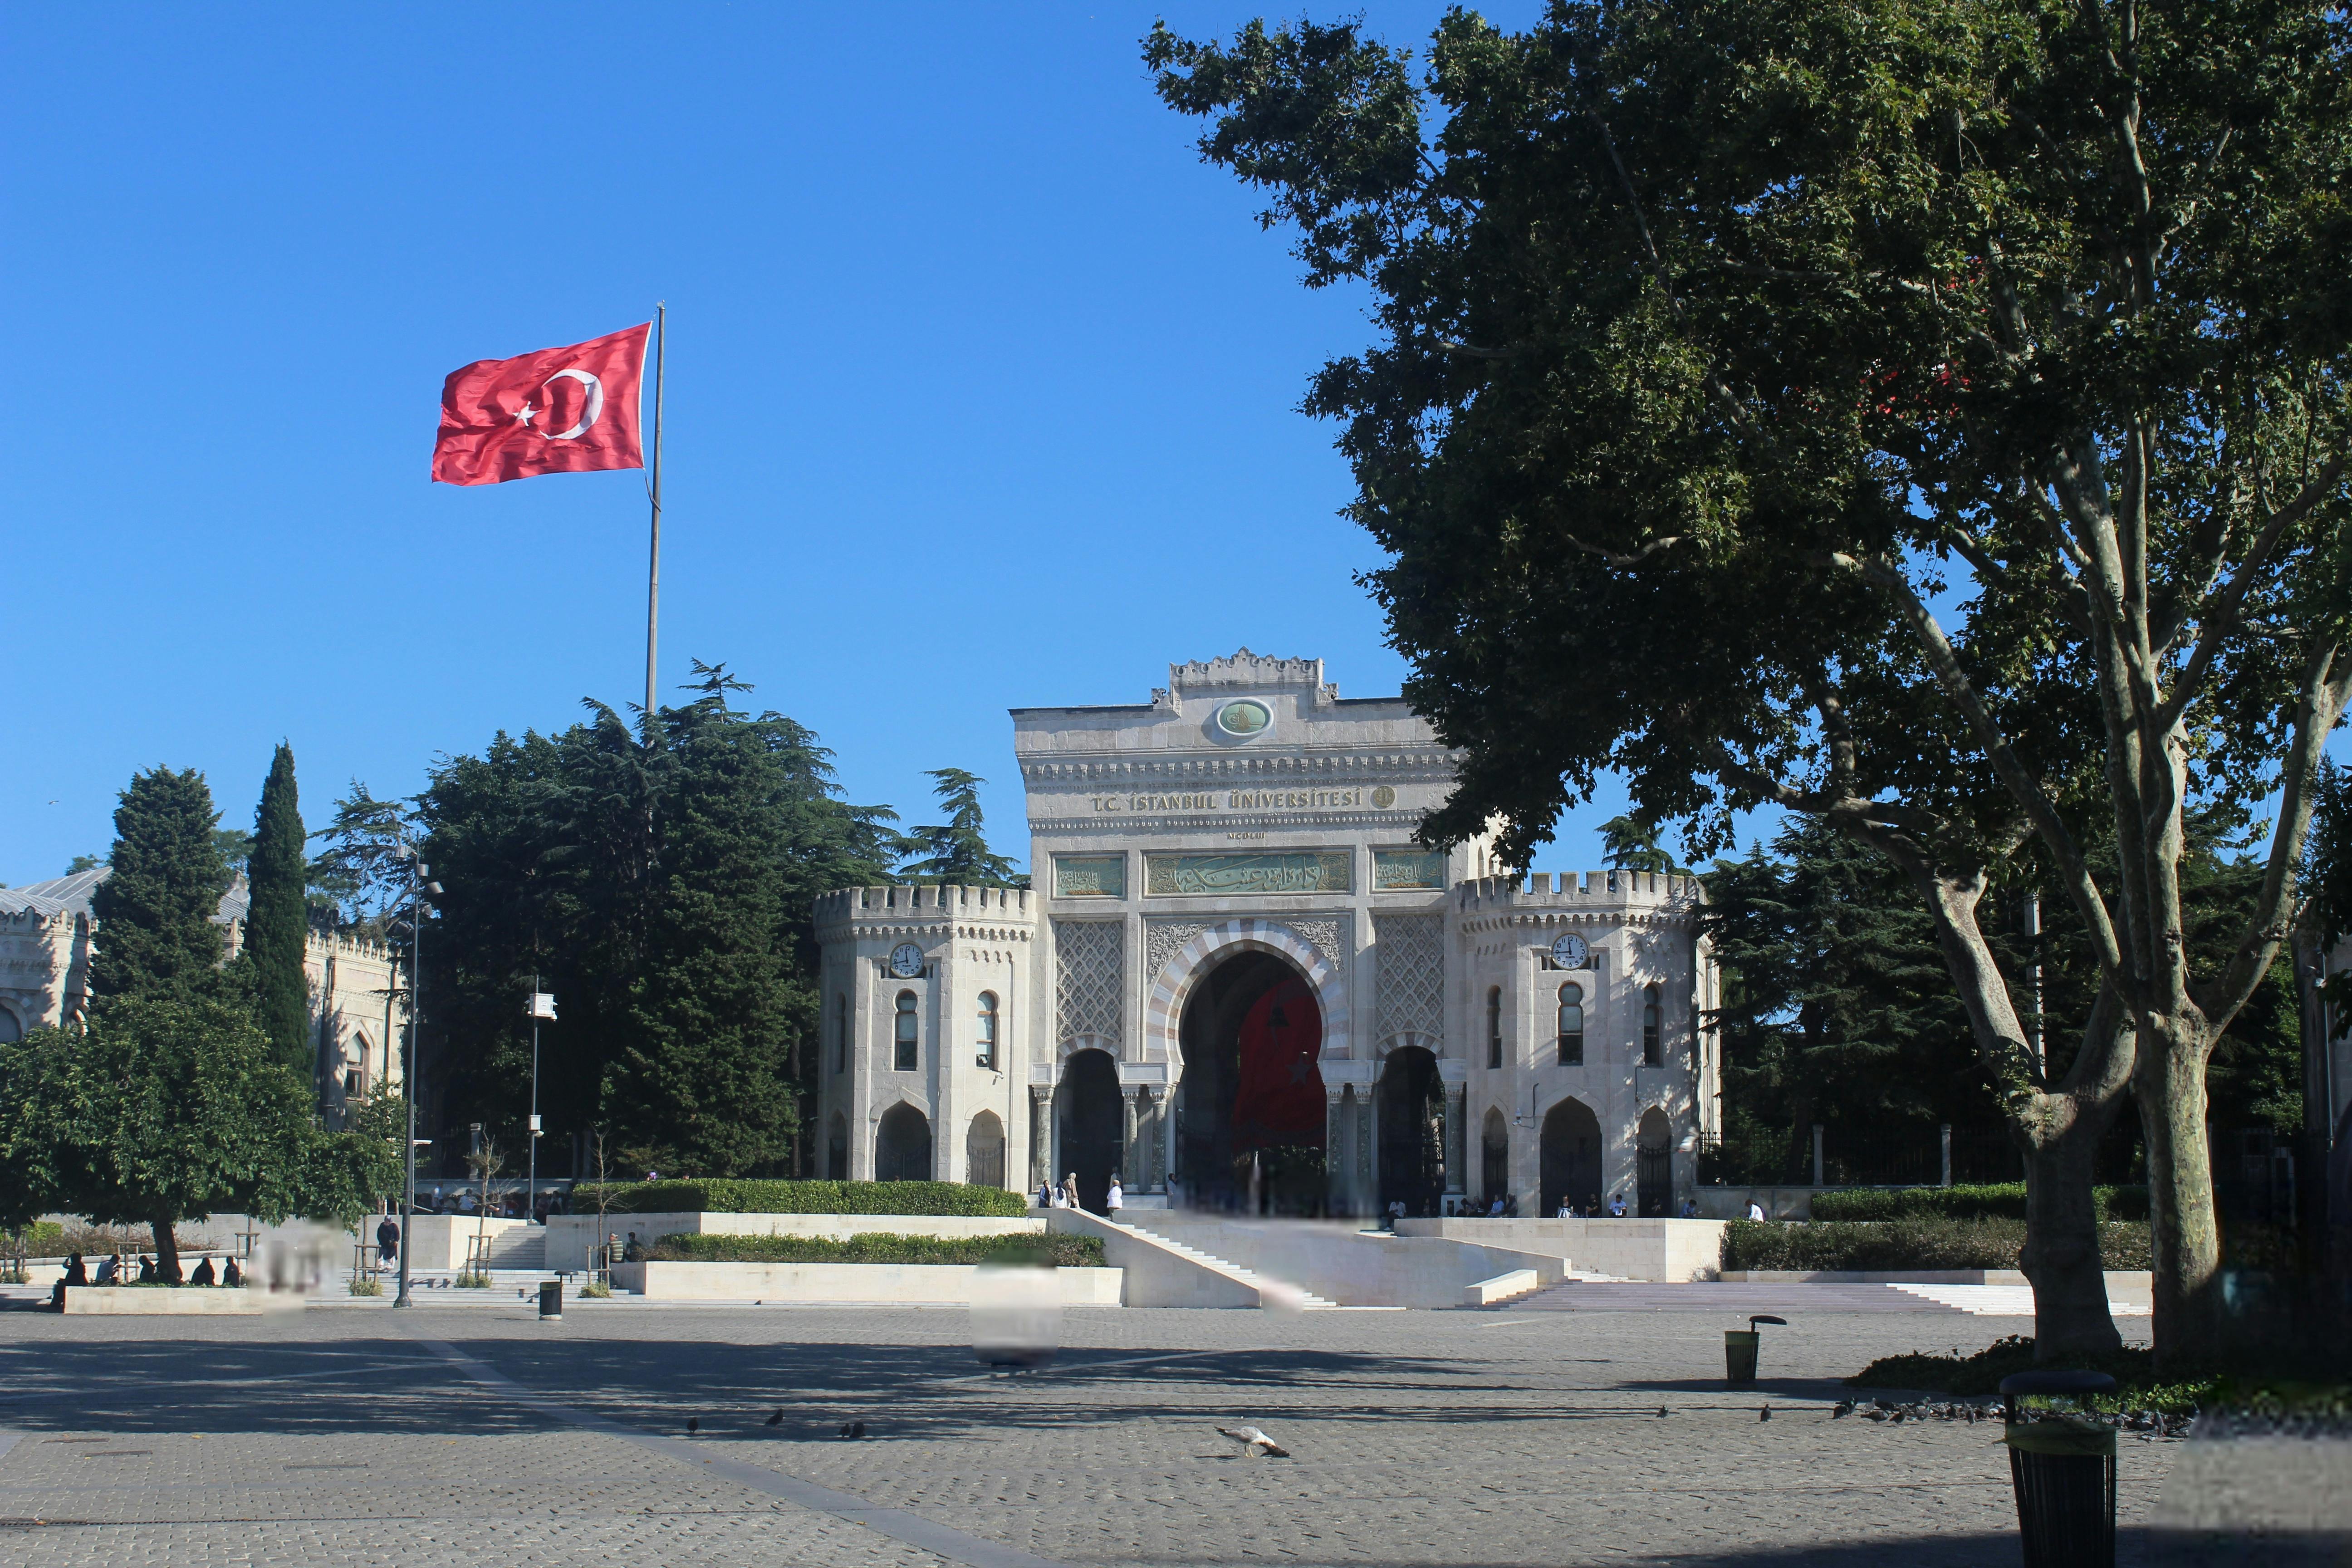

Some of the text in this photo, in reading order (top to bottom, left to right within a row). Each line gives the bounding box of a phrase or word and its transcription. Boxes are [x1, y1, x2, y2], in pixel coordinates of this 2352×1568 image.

[1091, 788, 1361, 811] T.C. İSTANBUL ÜNİVERSİTESİ
